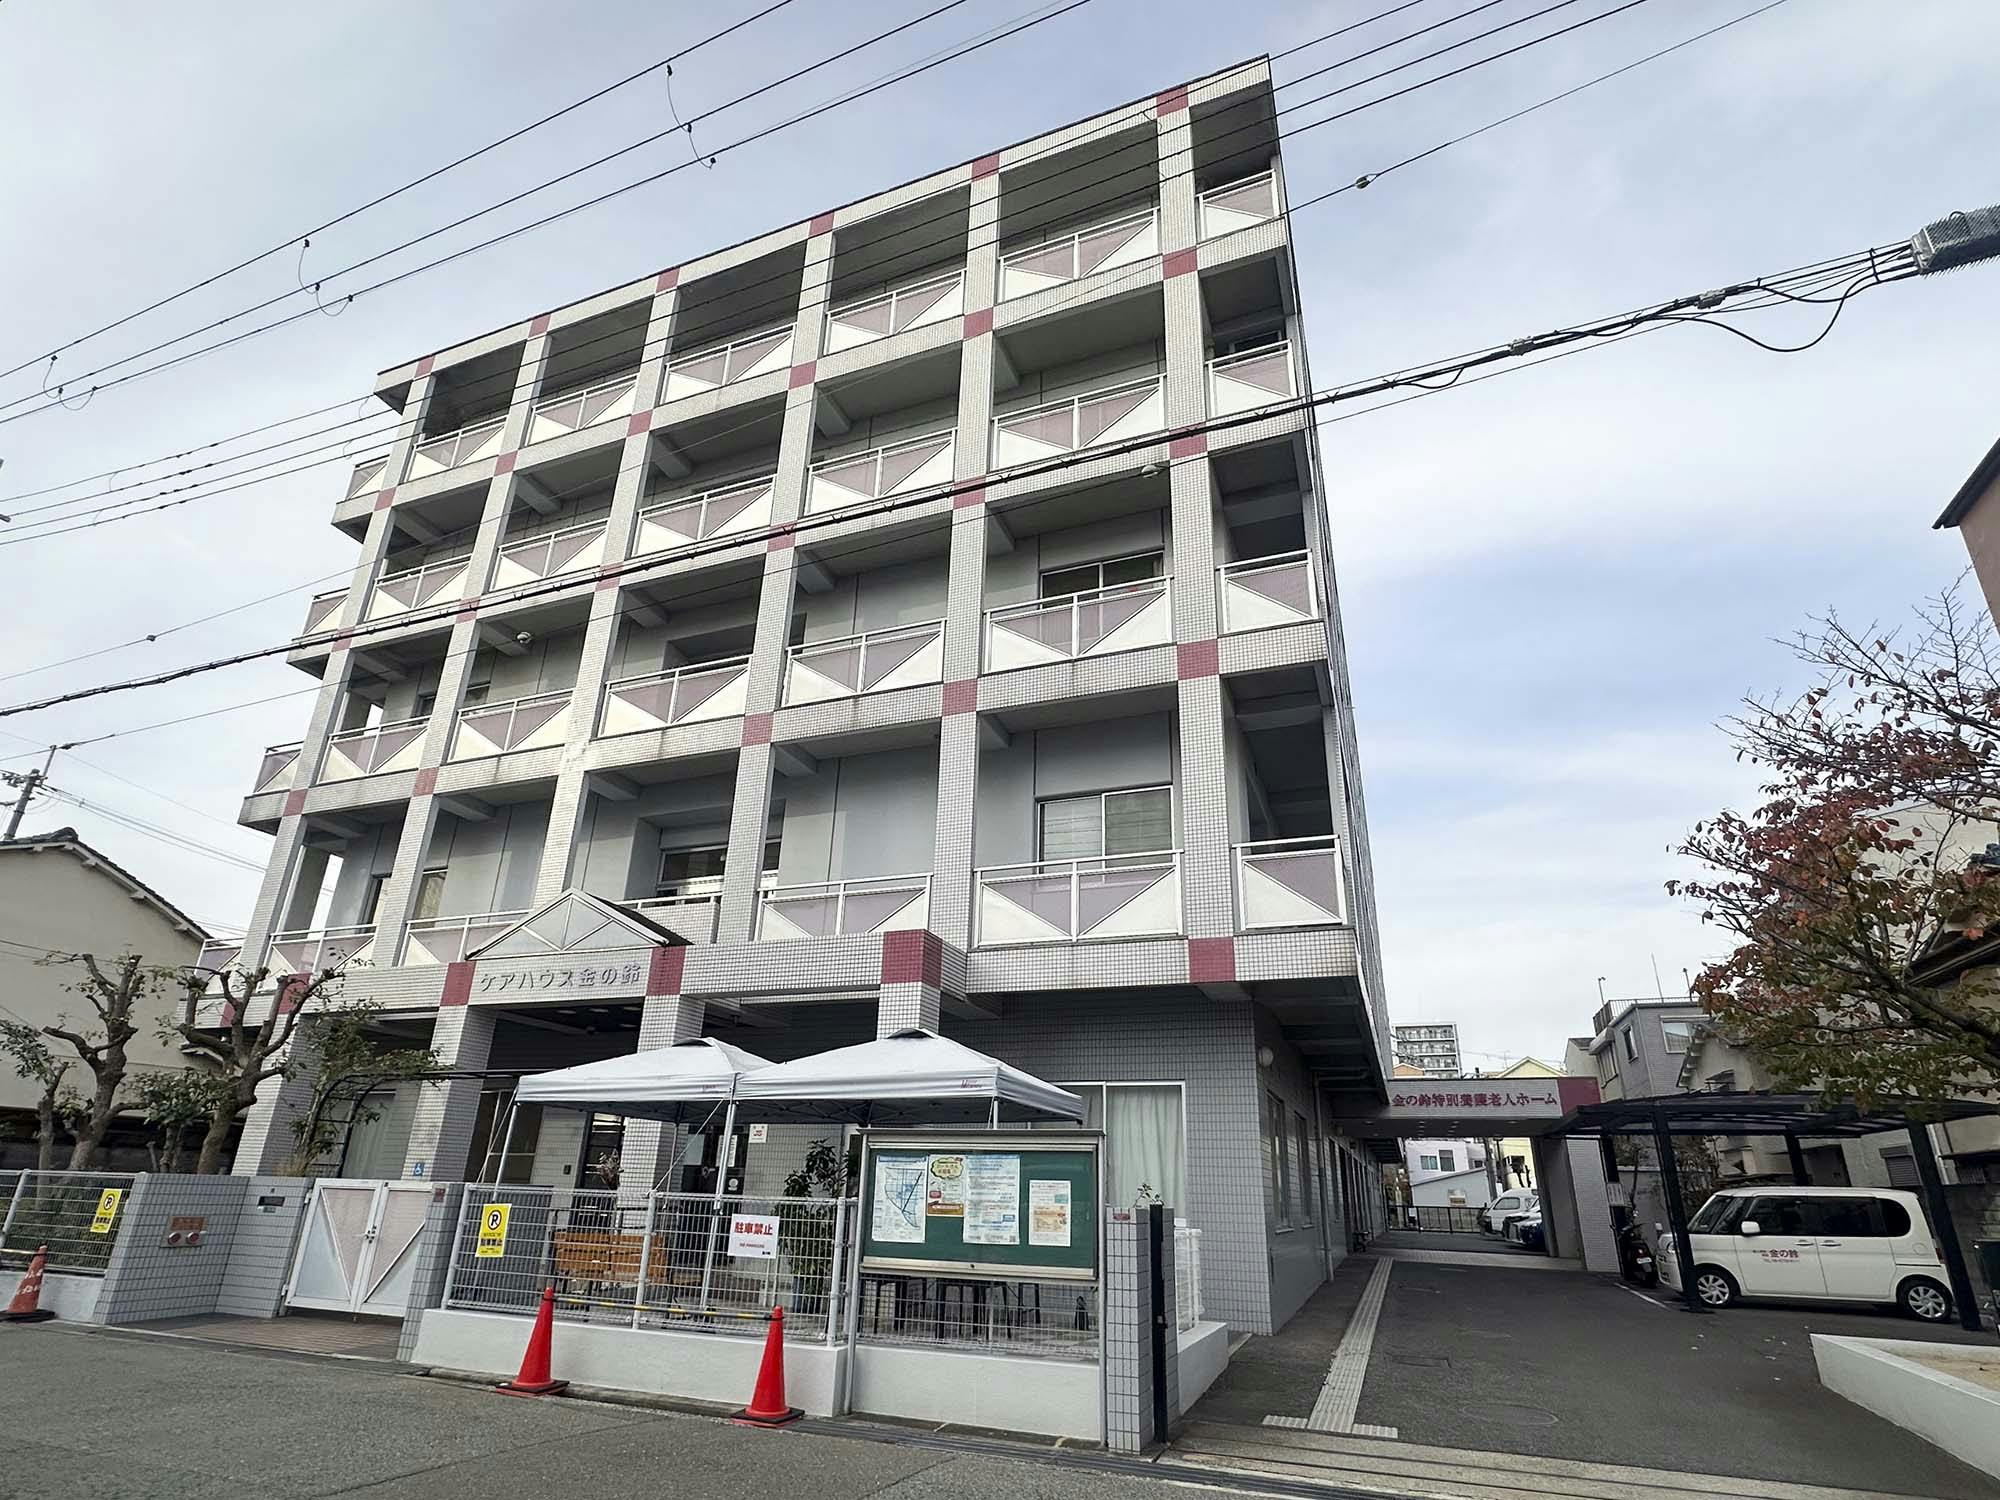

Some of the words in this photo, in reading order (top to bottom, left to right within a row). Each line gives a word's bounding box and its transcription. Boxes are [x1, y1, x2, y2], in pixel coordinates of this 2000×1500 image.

[480, 962, 642, 992] ケアハウス金の鈴
[1391, 1092, 1558, 1108] 金の鈴特別養護老人ホーム
[735, 1221, 773, 1235] 駐車禁止
[1769, 1249, 1799, 1258] 金の鈴
